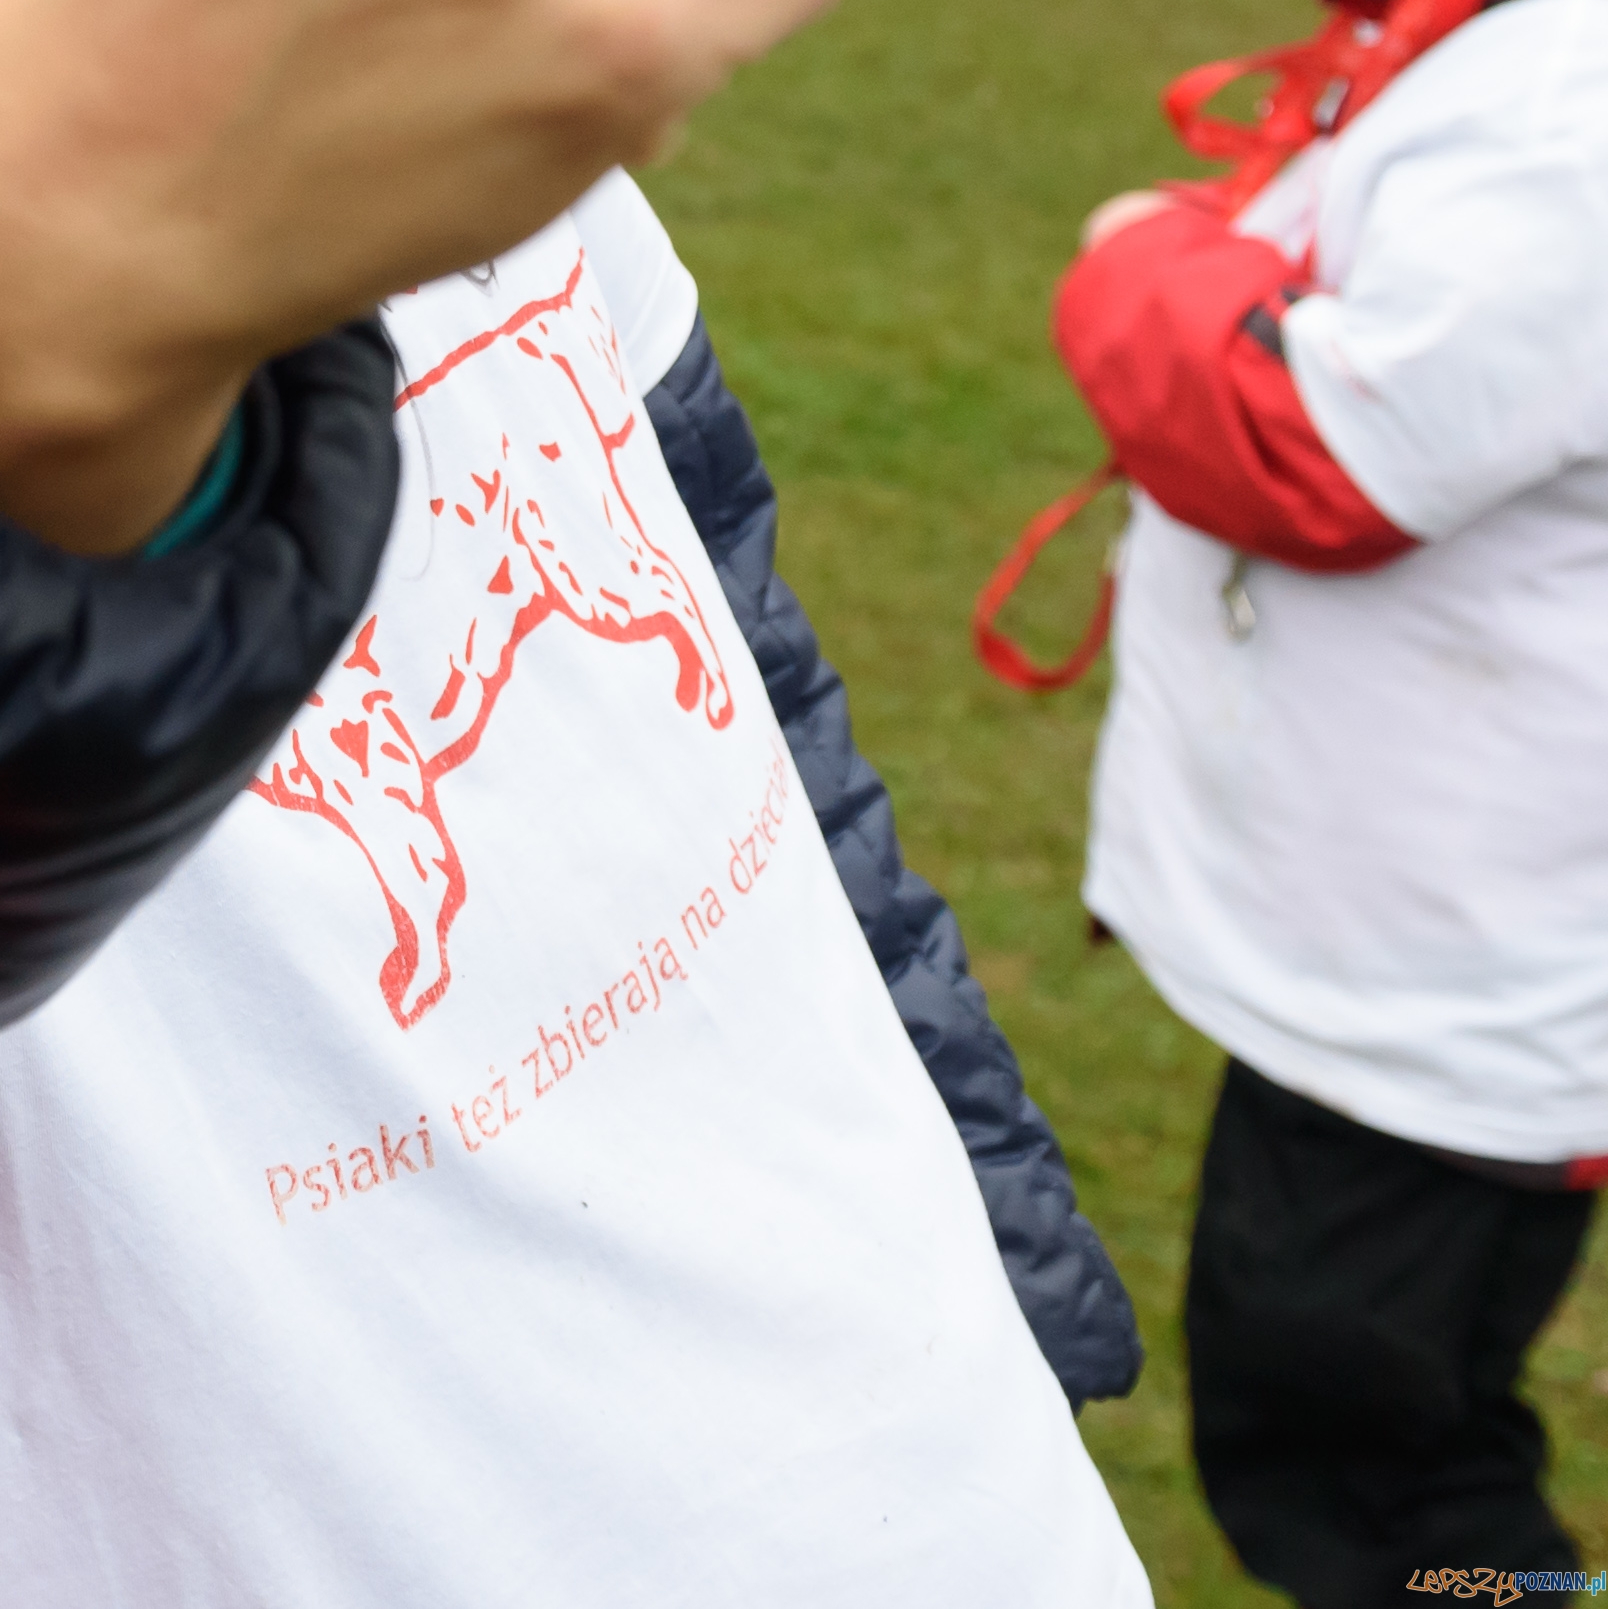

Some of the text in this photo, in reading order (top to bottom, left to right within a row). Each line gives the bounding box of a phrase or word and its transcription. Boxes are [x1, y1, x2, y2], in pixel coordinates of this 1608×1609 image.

[264, 1114, 437, 1226] Psiaki
[450, 1063, 523, 1154] też
[520, 935, 689, 1100] zbierają
[680, 885, 727, 952] na
